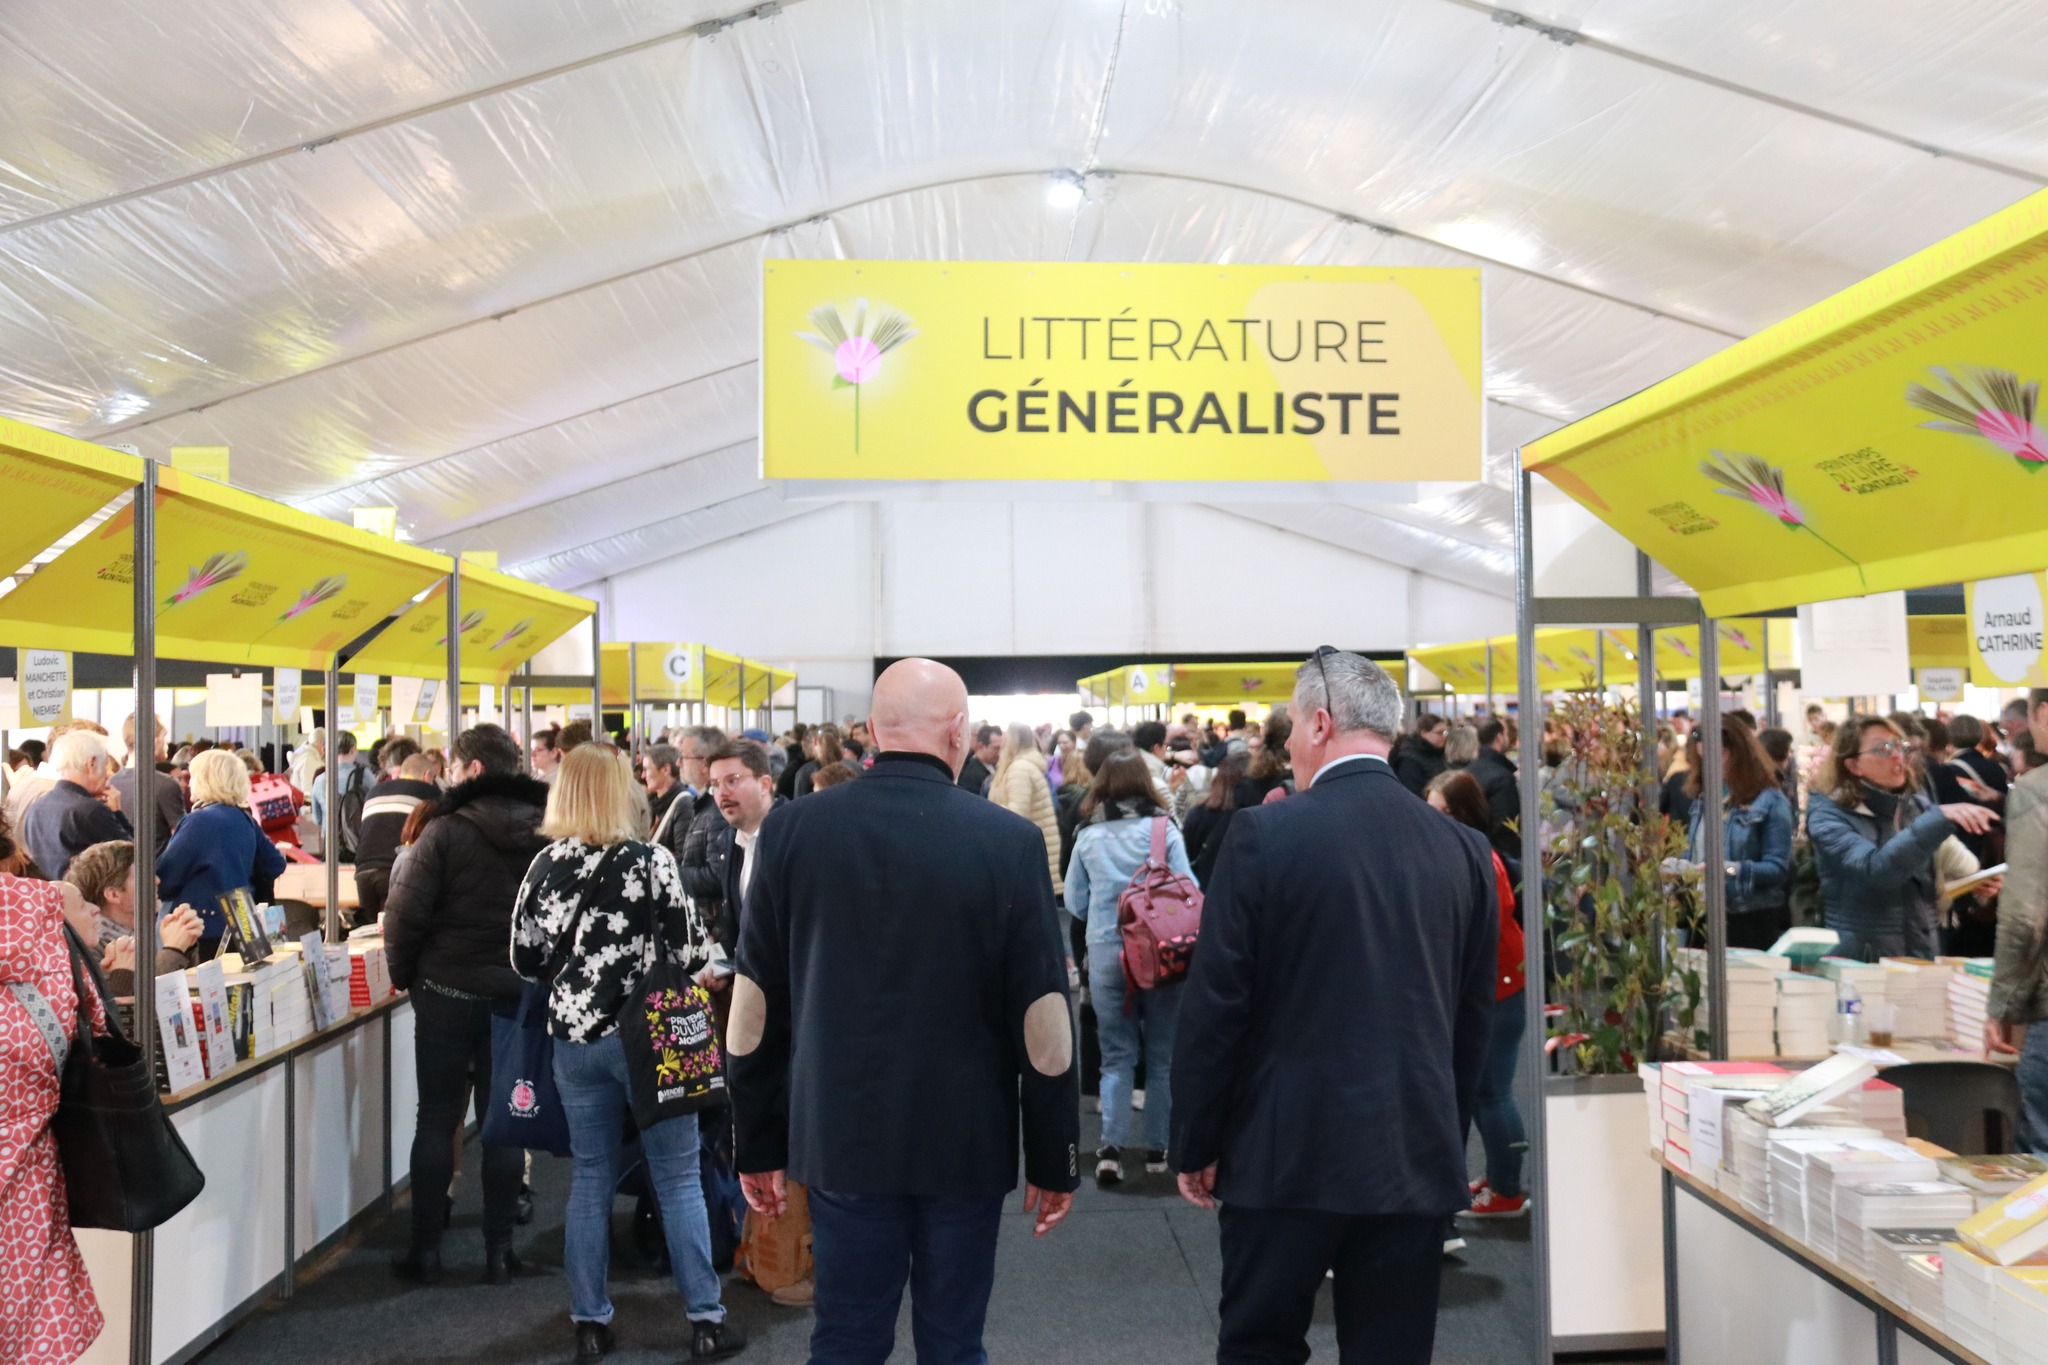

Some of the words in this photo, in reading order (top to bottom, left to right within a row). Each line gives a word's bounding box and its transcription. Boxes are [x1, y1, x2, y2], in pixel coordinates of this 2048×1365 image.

[983, 307, 1387, 363] LITTÉRATURE
[967, 378, 1400, 435] GÉNÉRALISTE
[1817, 446, 1881, 472] PRINTEMPS
[1849, 458, 1899, 481] LIVRE
[1984, 606, 2032, 629] Arnaud
[1976, 632, 2043, 653] CATHRINE
[33, 654, 59, 666] Ludovic
[669, 655, 686, 677] C
[25, 671, 67, 682] MANCHETTE
[1132, 674, 1144, 688] A
[28, 690, 35, 700] et
[36, 687, 66, 699] Christian
[33, 703, 61, 716] NIEMIEC
